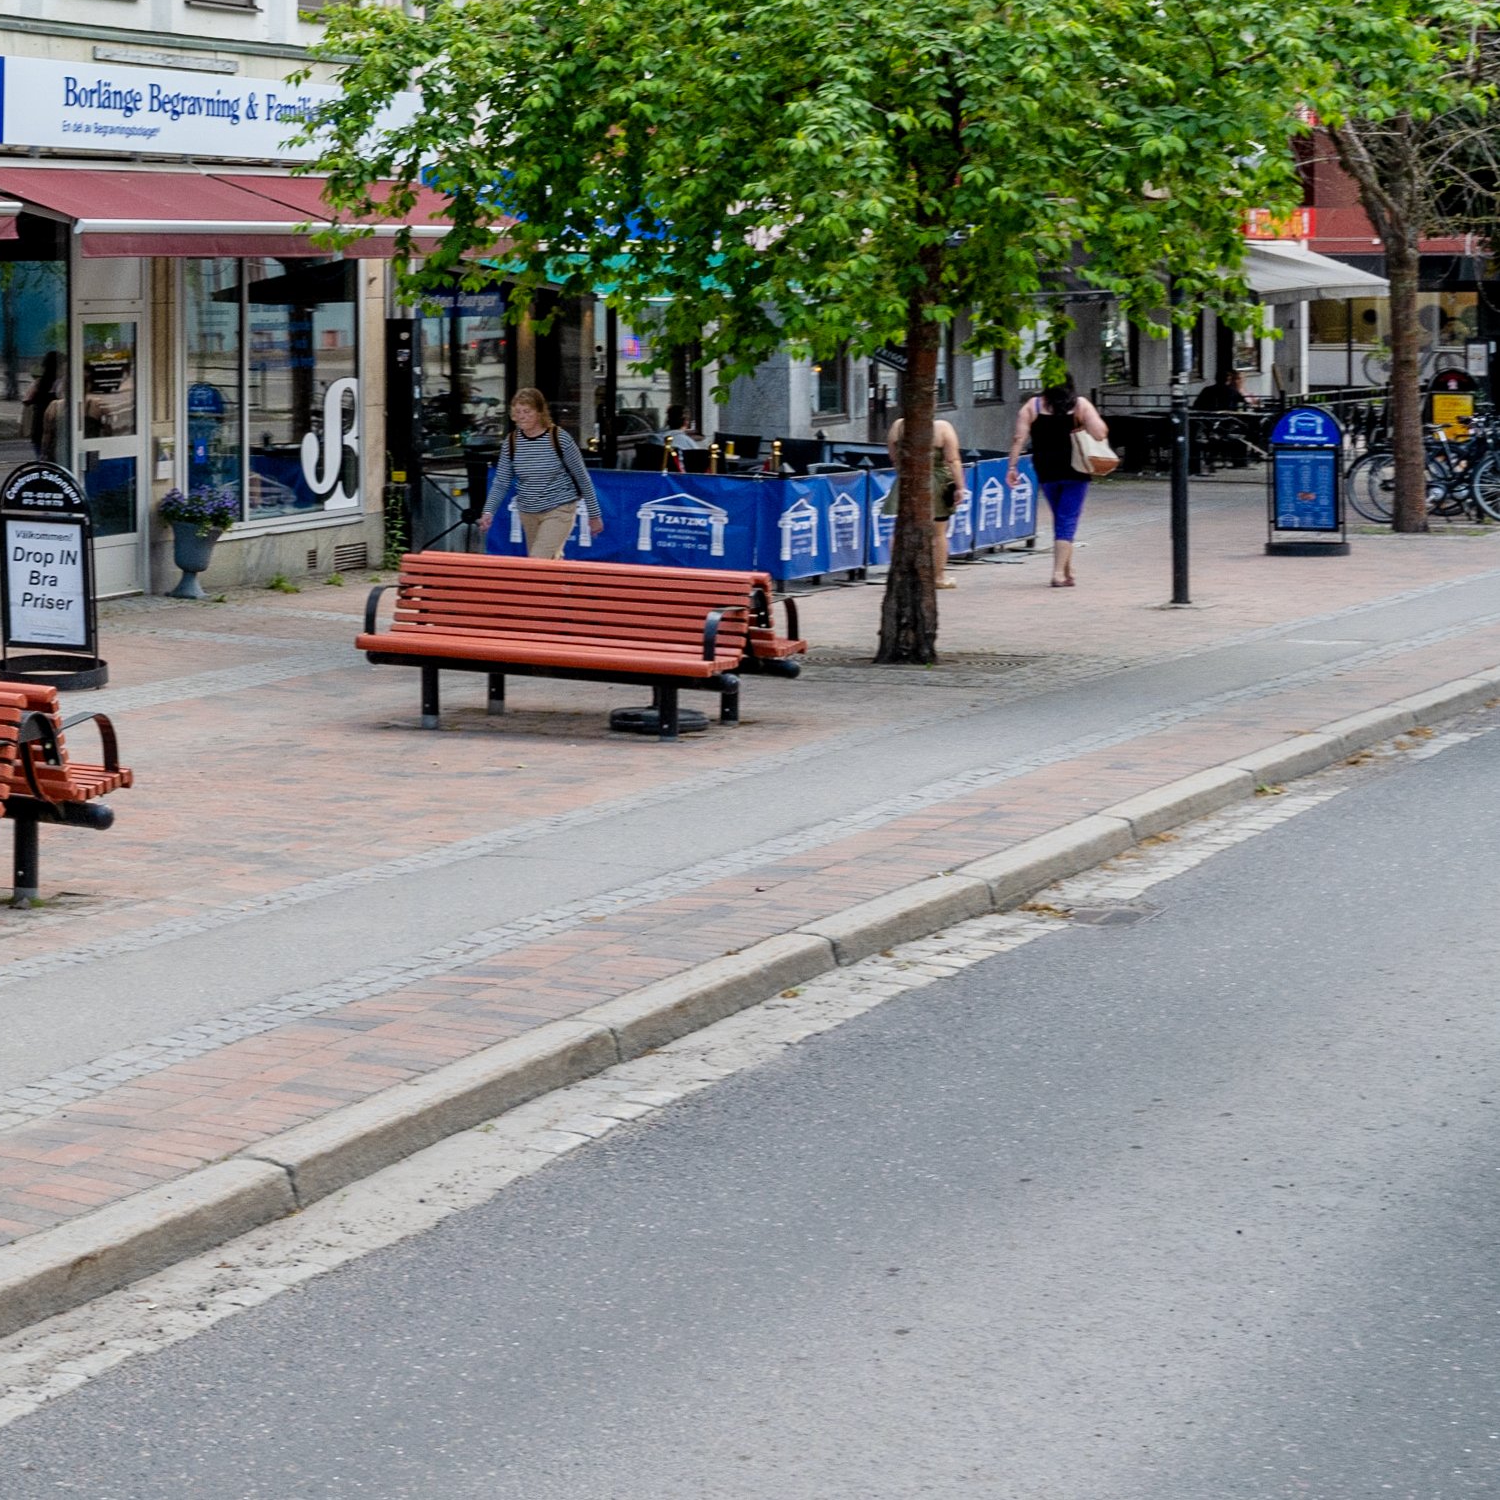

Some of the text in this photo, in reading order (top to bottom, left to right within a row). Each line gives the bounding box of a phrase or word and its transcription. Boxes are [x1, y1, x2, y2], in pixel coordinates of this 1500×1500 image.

[63, 76, 143, 117] Borlänge
[148, 83, 239, 125] Begravning
[245, 92, 259, 121] &
[13, 546, 78, 567] Drop IN
[28, 570, 58, 587] Bra
[21, 592, 74, 611] Priser
